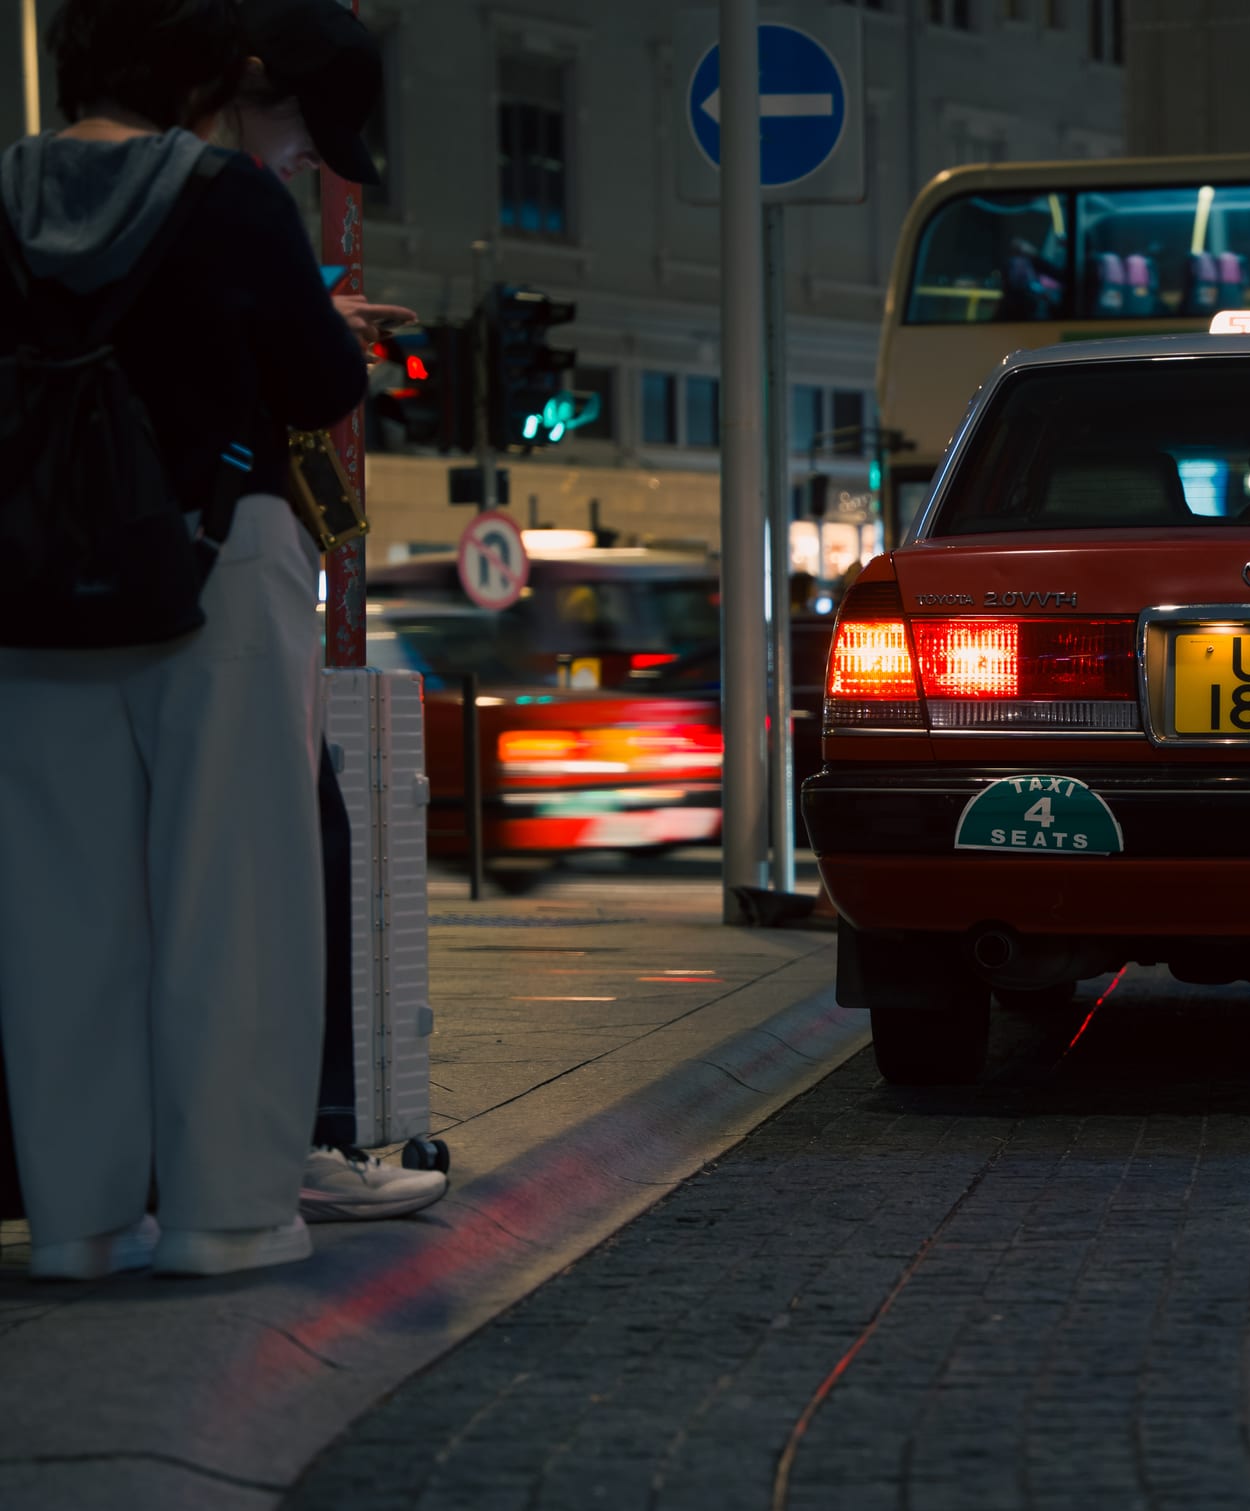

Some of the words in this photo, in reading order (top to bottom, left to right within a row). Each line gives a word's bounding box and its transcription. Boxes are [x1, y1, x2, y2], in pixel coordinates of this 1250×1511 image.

[915, 594, 974, 606] TOYOTA
[1008, 776, 1076, 798] TAXI
[1024, 797, 1055, 828] 4
[990, 829, 1089, 849] SEATS
